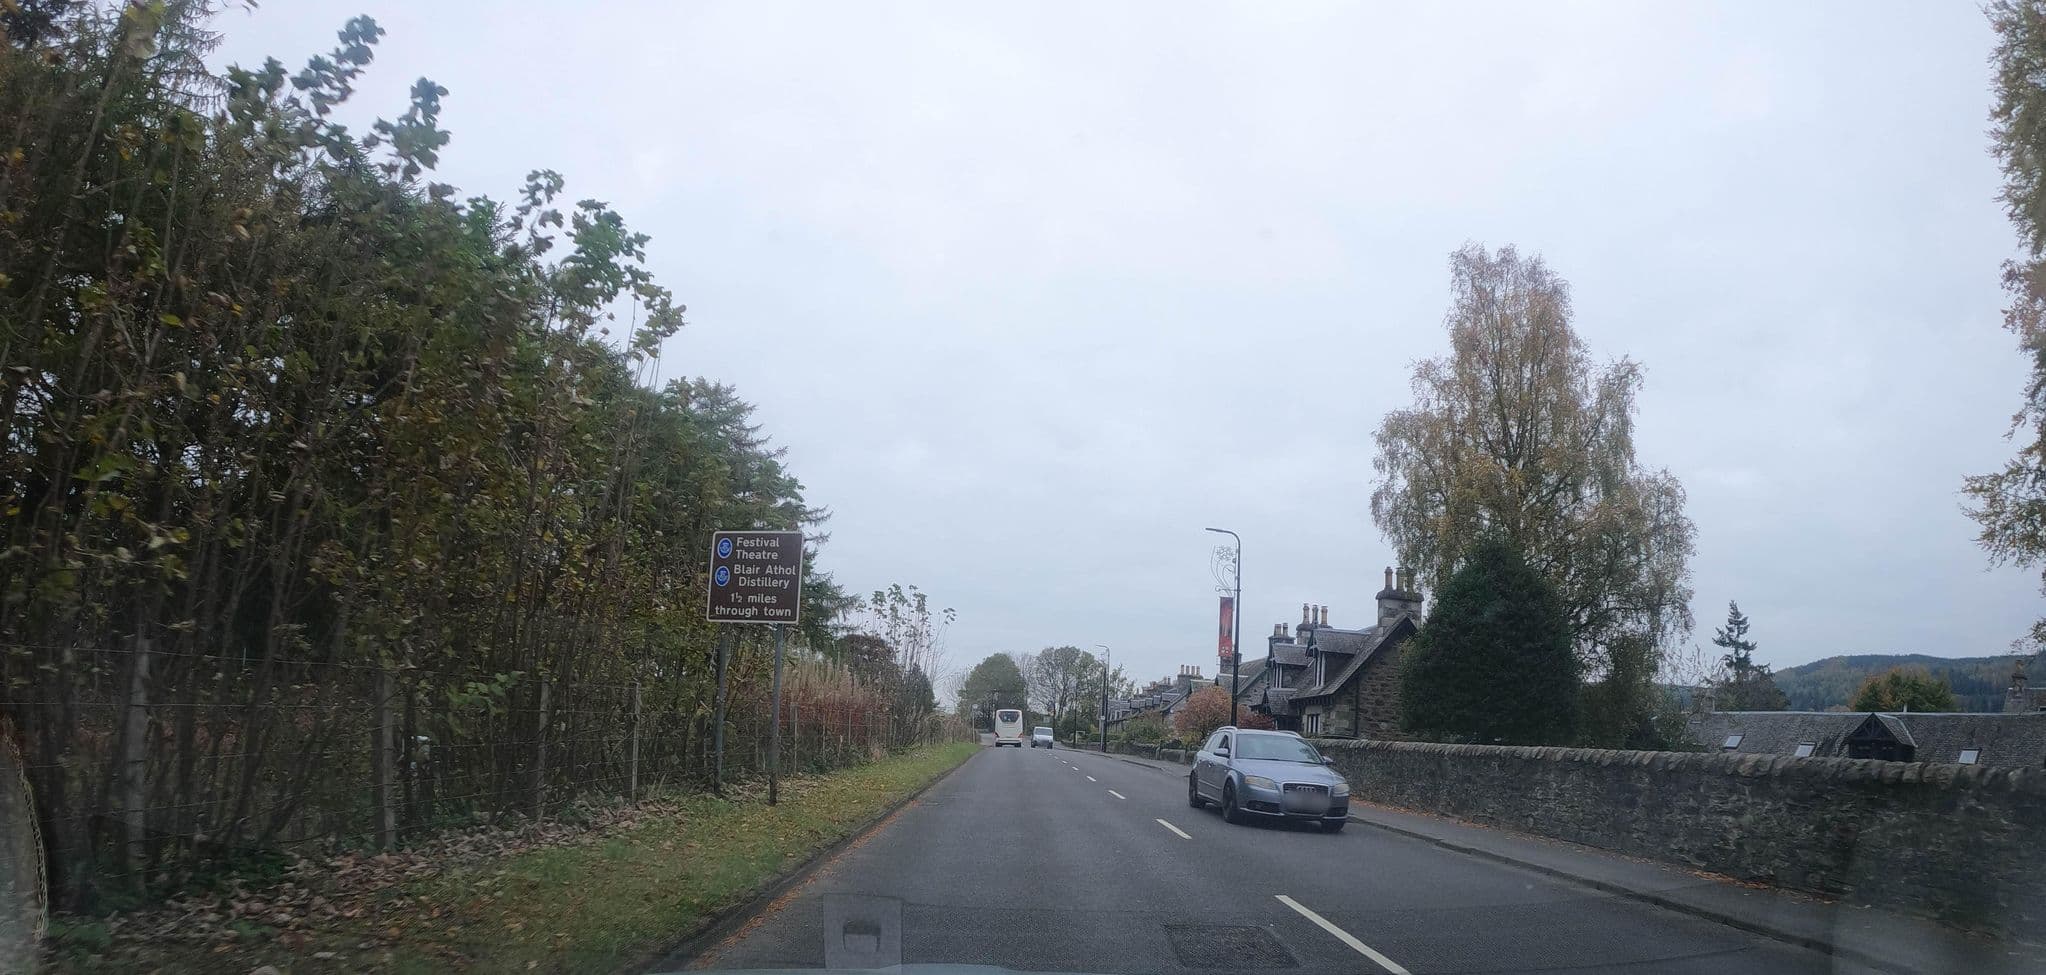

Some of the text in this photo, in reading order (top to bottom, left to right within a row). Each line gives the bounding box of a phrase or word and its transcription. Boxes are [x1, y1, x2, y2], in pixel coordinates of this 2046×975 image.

[736, 537, 780, 547] Festival
[736, 549, 778, 560] Theatre
[734, 564, 796, 575] Blair Athol
[738, 576, 790, 589] Distillery
[747, 593, 777, 604] miles
[715, 605, 791, 618] through town
